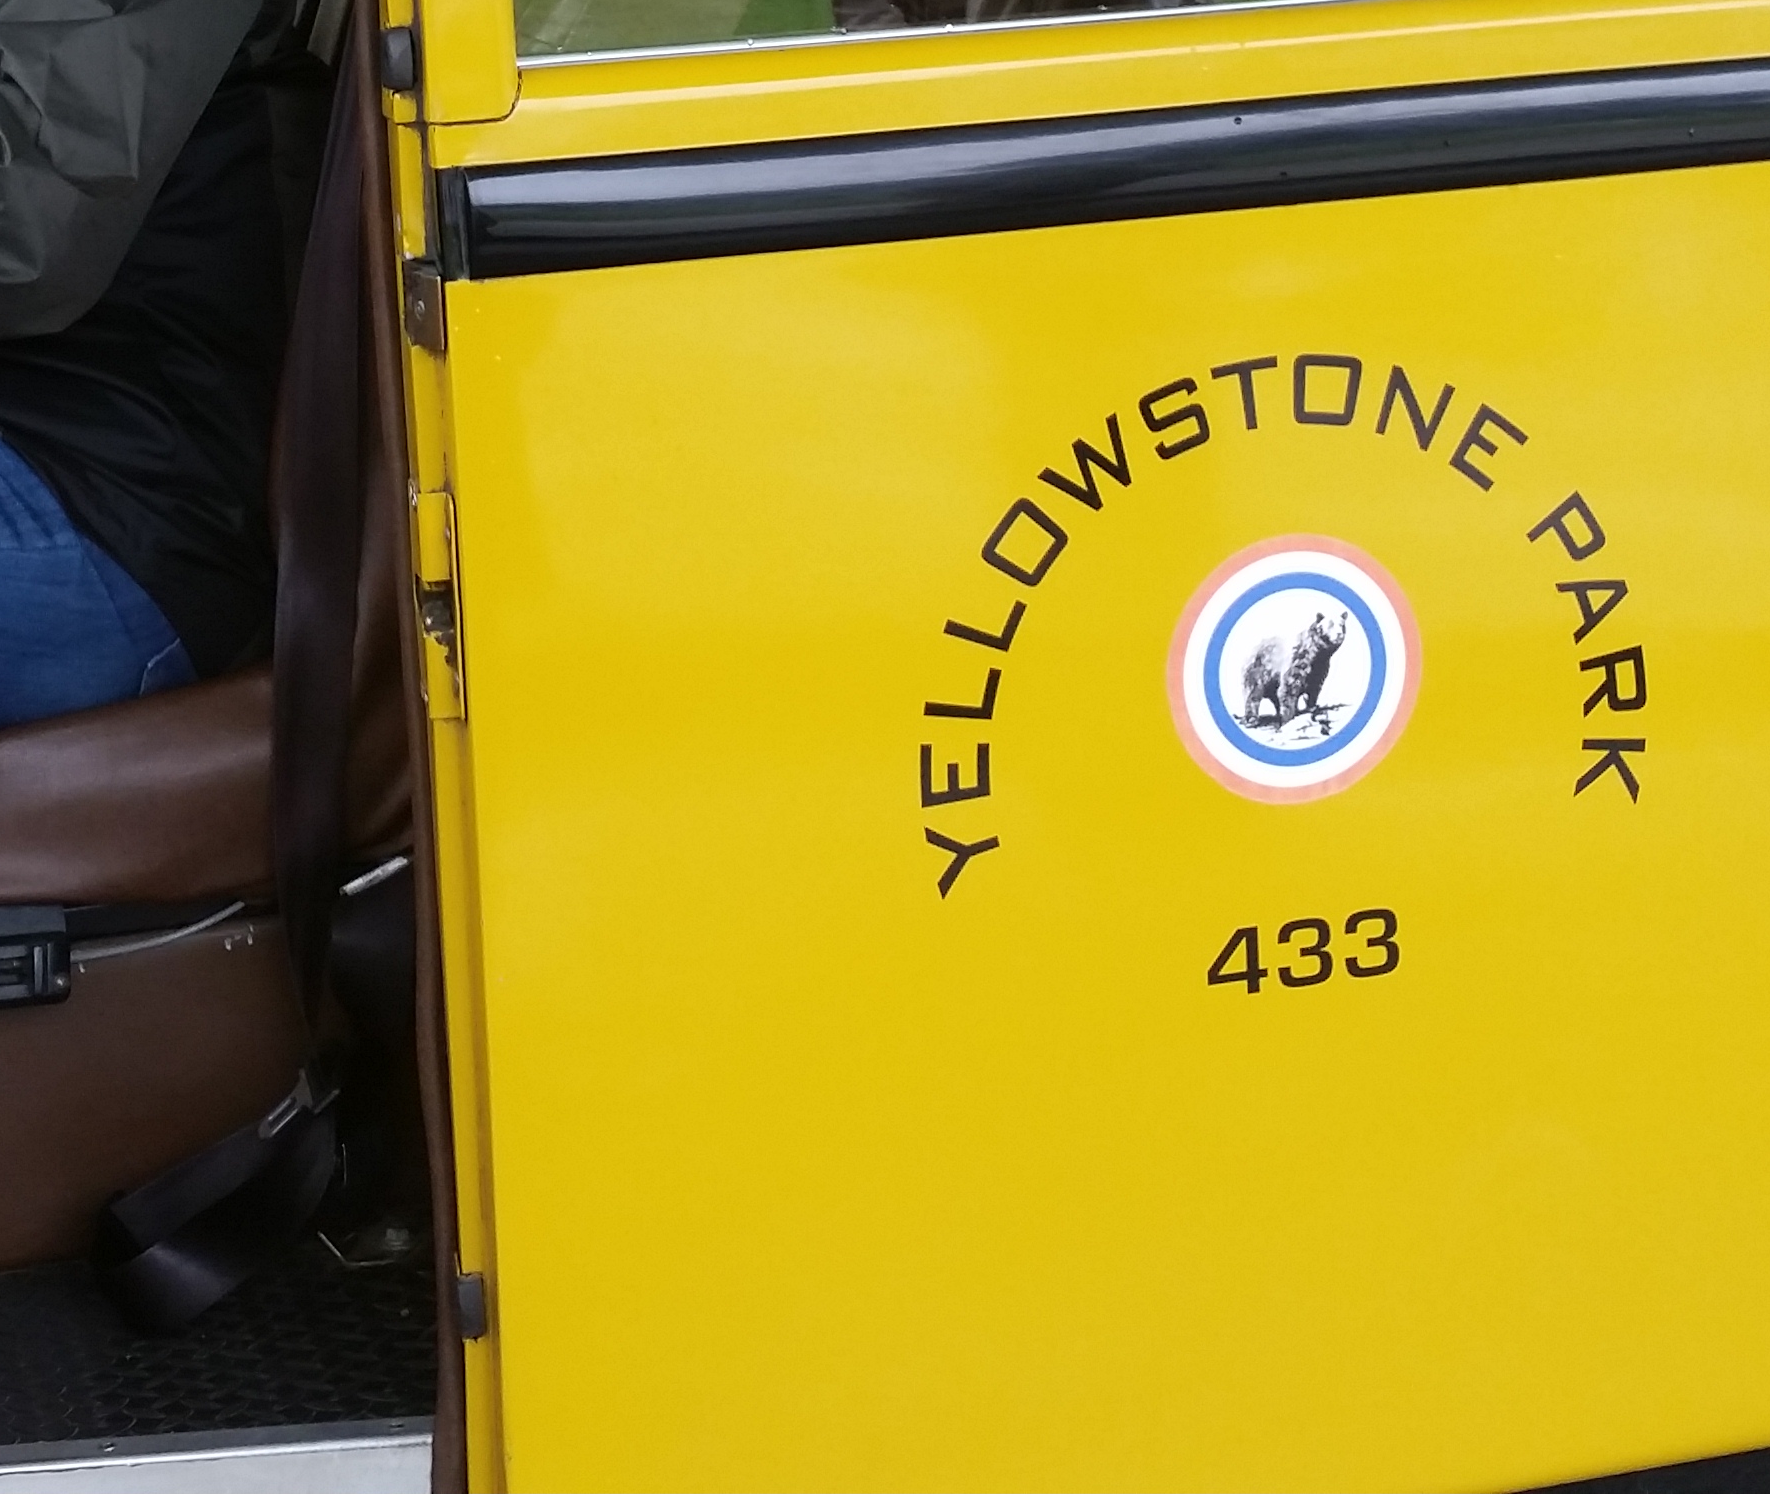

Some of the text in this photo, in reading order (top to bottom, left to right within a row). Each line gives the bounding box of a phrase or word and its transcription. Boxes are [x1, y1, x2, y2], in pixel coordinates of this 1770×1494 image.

[919, 352, 1648, 900] YELLOWSTONE PARK
[1206, 908, 1401, 995] 433
